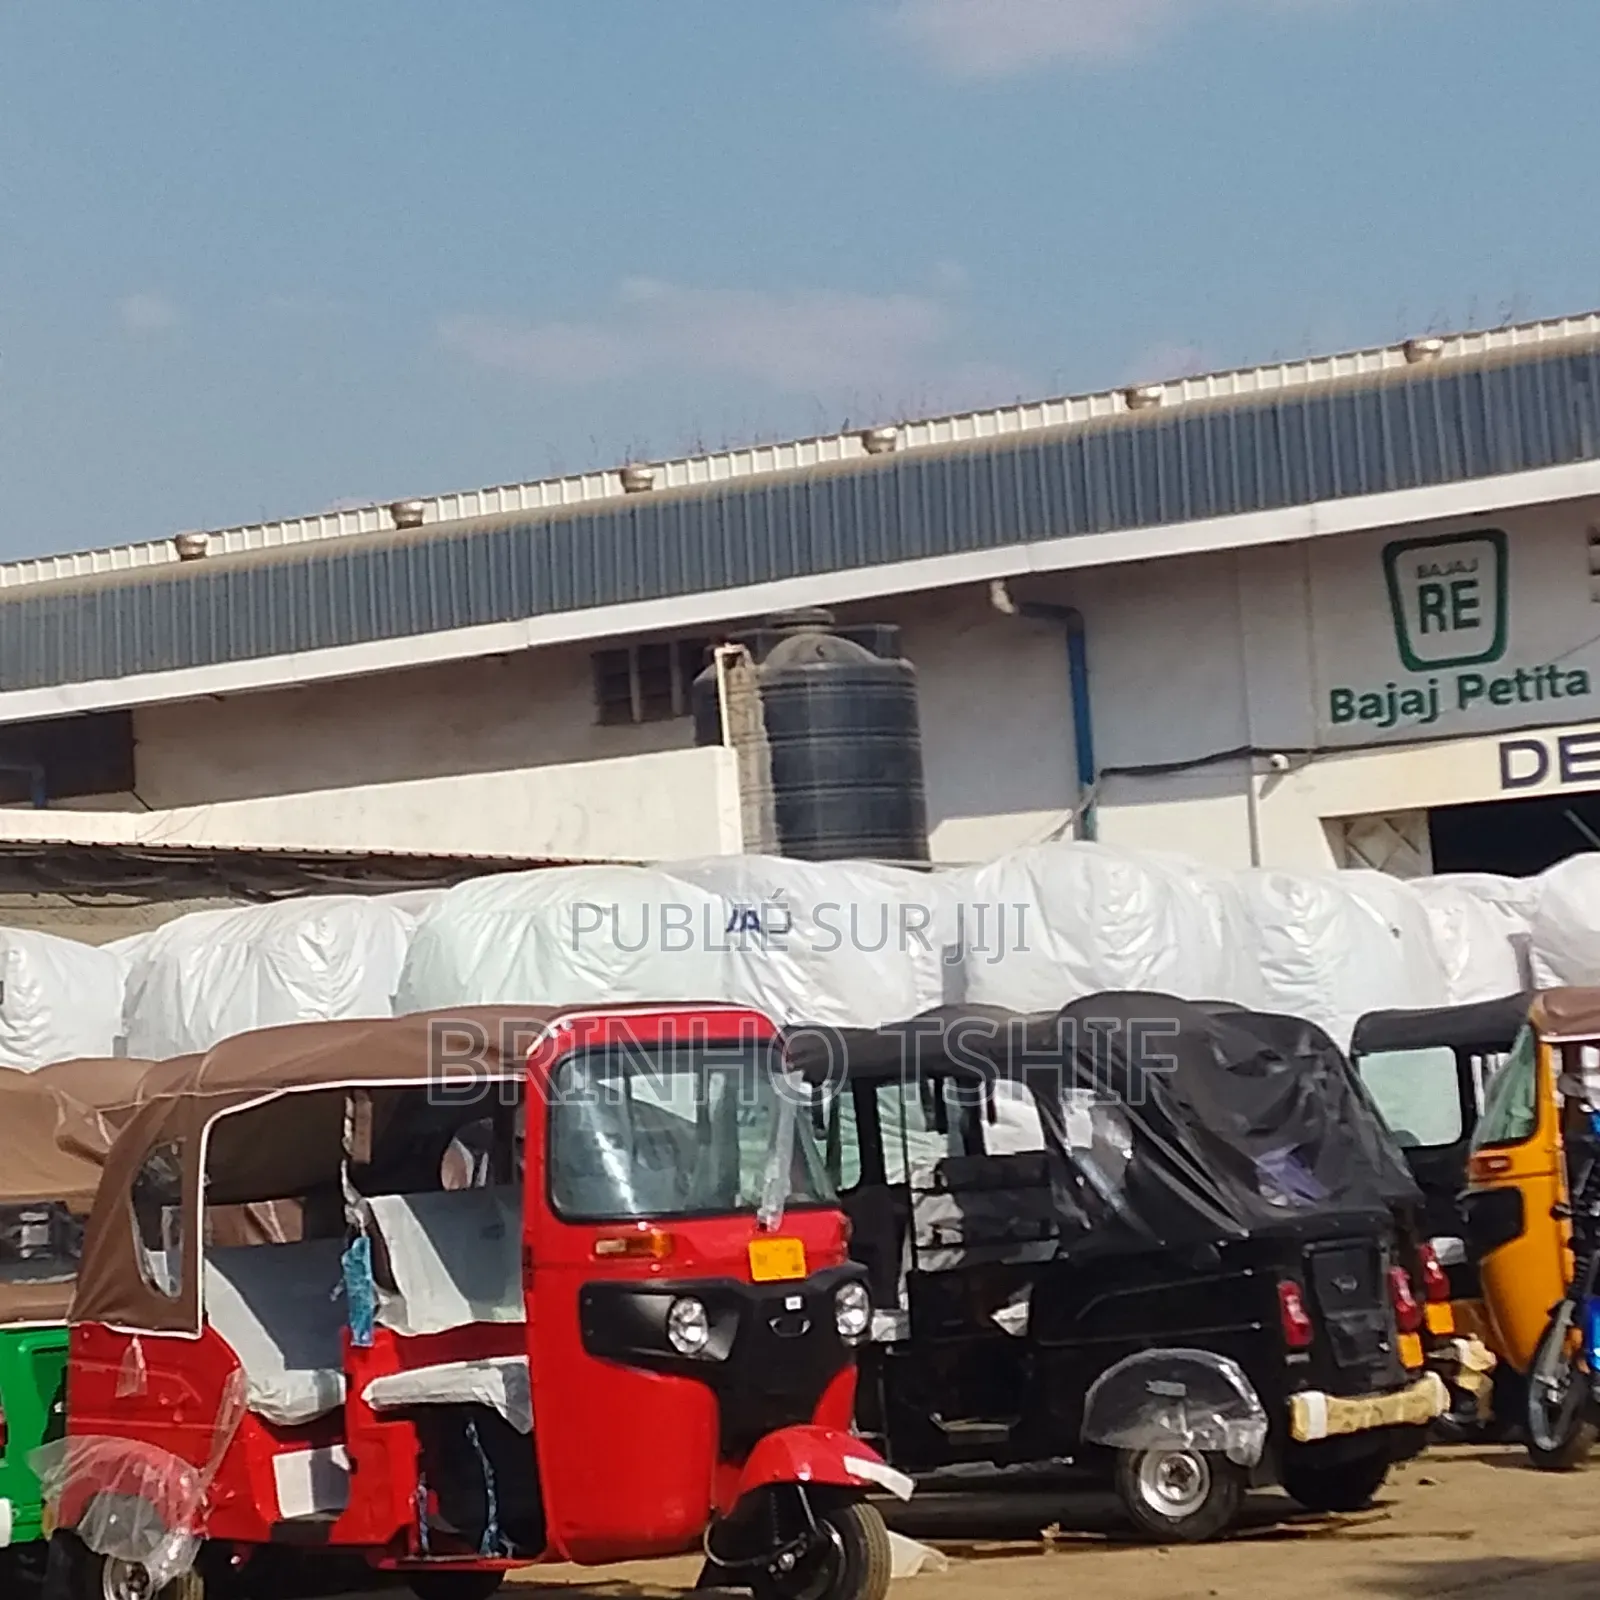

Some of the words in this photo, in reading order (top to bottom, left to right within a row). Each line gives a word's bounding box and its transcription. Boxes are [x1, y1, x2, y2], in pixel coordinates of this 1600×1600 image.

[1417, 558, 1479, 579] BAJAJ
[1417, 579, 1481, 635] RE
[1329, 678, 1440, 728] Bajaj
[1457, 664, 1591, 710] Petita
[1499, 732, 1600, 790] DE
